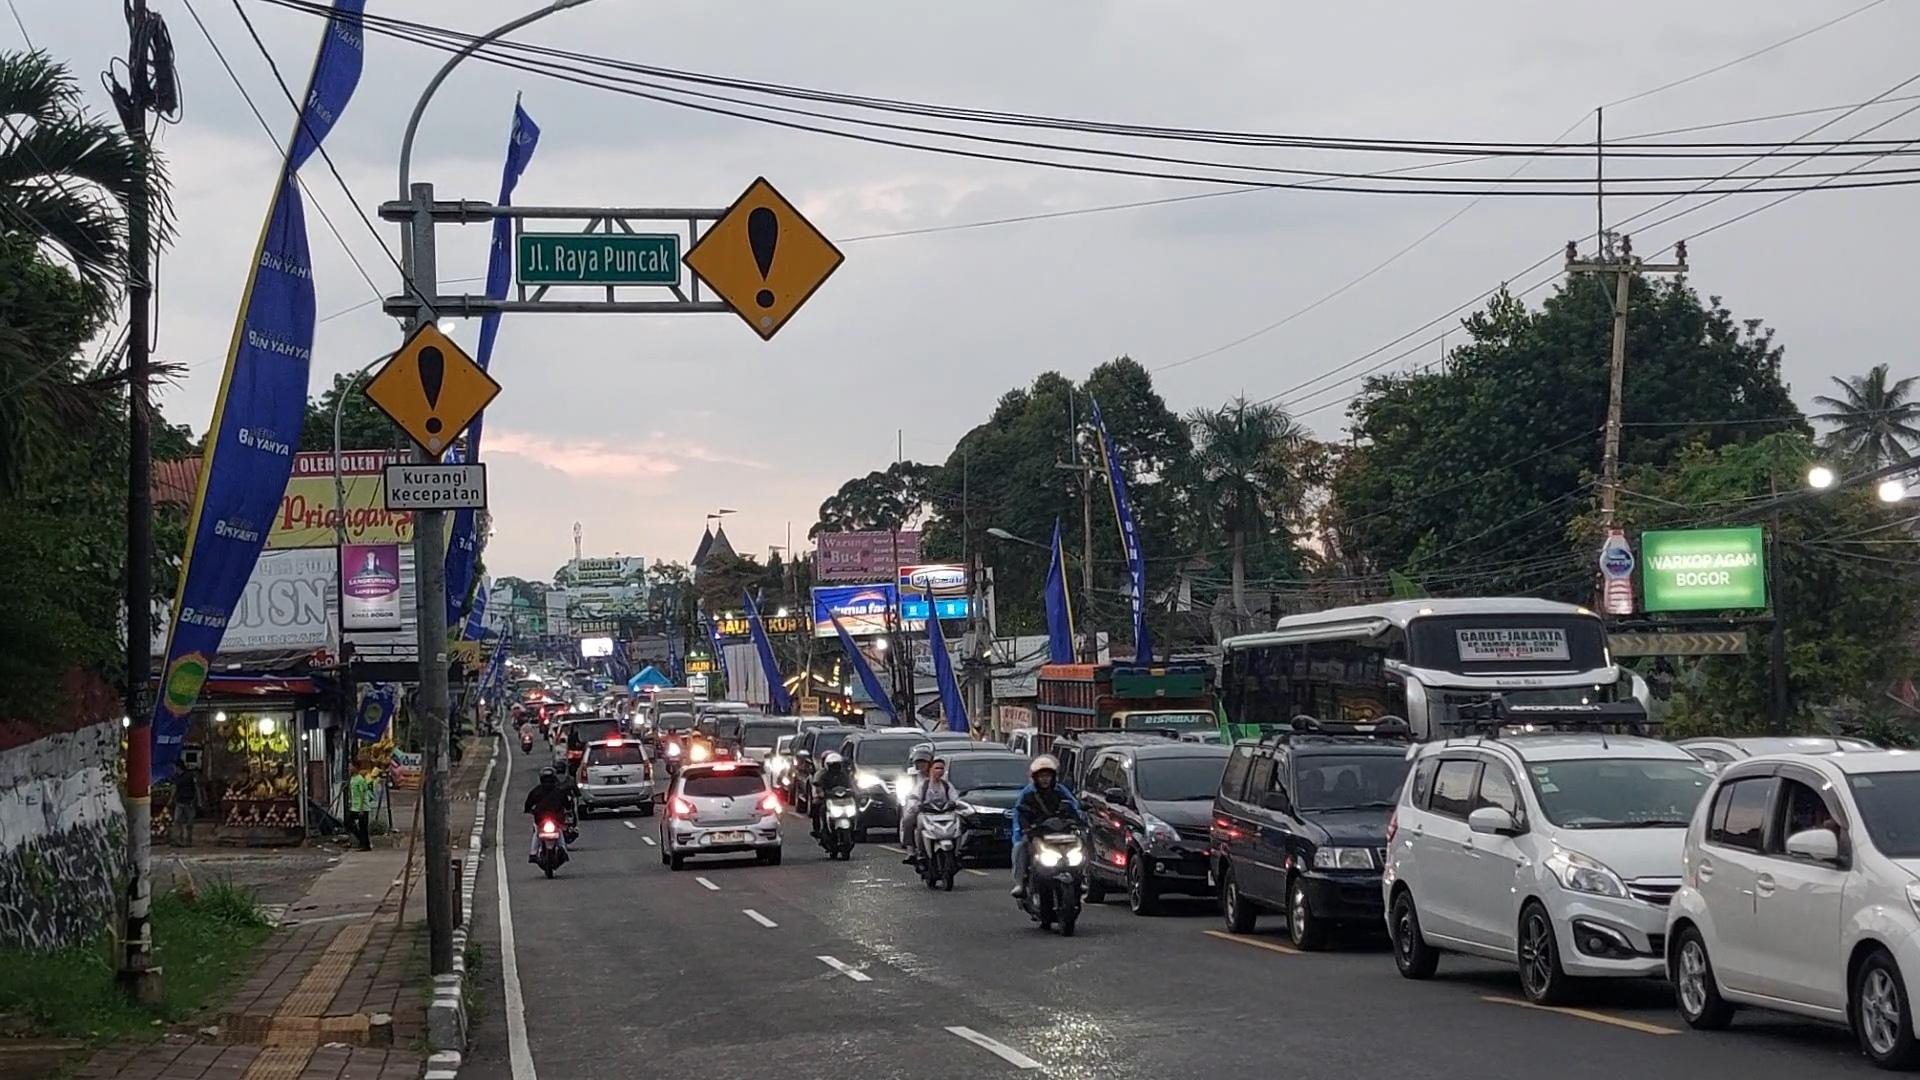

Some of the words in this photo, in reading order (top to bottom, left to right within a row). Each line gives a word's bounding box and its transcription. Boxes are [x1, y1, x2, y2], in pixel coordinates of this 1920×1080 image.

[260, 251, 281, 270] BIN
[528, 243, 549, 271] Jl.
[555, 245, 598, 279] Raya
[604, 244, 669, 272] Puncak
[248, 330, 269, 350] BIN
[271, 339, 310, 360] YAHYA
[256, 437, 289, 456] YAHYA
[300, 456, 334, 472] OLEH
[342, 456, 375, 471] OLEH
[403, 470, 467, 486] Kurangi
[392, 487, 479, 503] Kecepatan
[1648, 555, 1713, 570] WARKOP
[1714, 553, 1757, 568] AGAM
[1676, 572, 1730, 587] BOGOR
[1460, 631, 1562, 642] GARUT-JAKARTA
